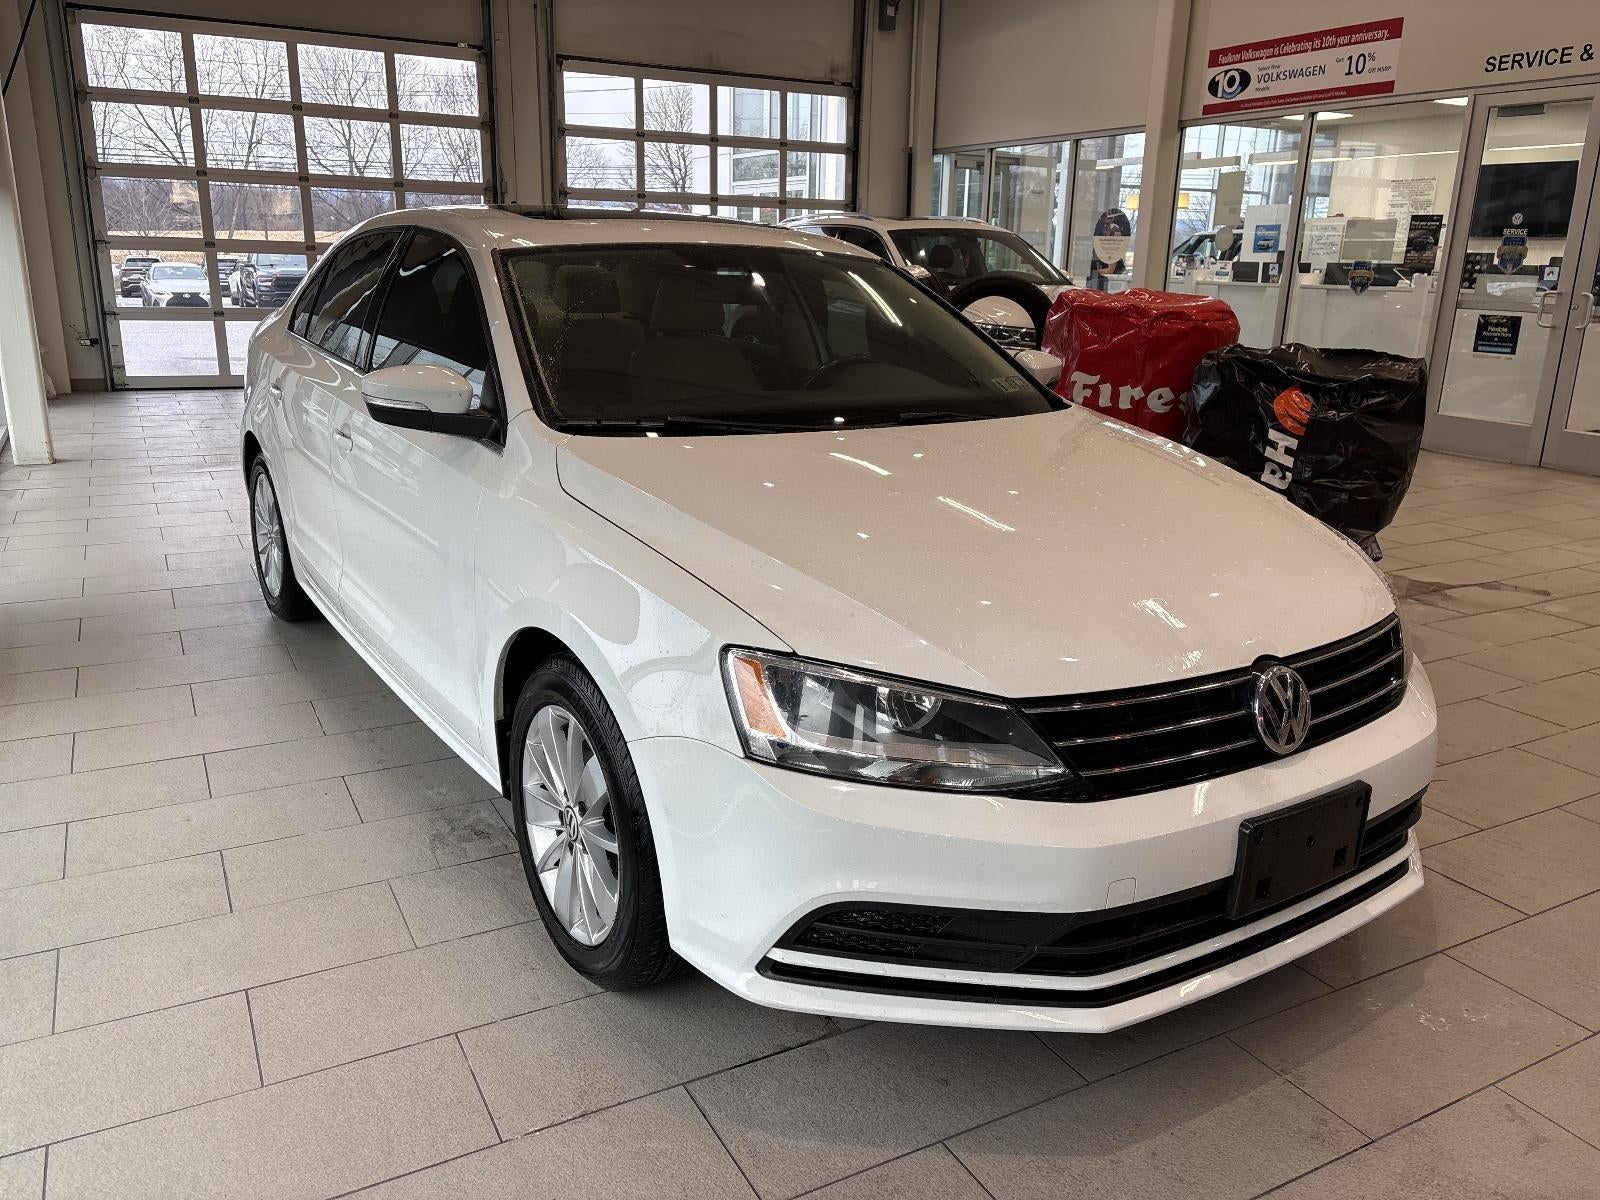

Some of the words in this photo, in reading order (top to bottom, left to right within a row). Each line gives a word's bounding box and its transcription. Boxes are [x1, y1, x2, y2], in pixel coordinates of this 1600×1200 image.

[1241, 47, 1274, 60] Volkswagen
[1273, 45, 1279, 55] is
[1279, 40, 1313, 54] Celebrating
[1312, 38, 1321, 49] its
[1321, 34, 1336, 47] 10th
[1336, 35, 1351, 47] year
[1484, 45, 1575, 73] SERVICE
[1579, 43, 1595, 62] &
[1257, 64, 1327, 84] VOLKSWAGEN
[1344, 52, 1367, 76] 10
